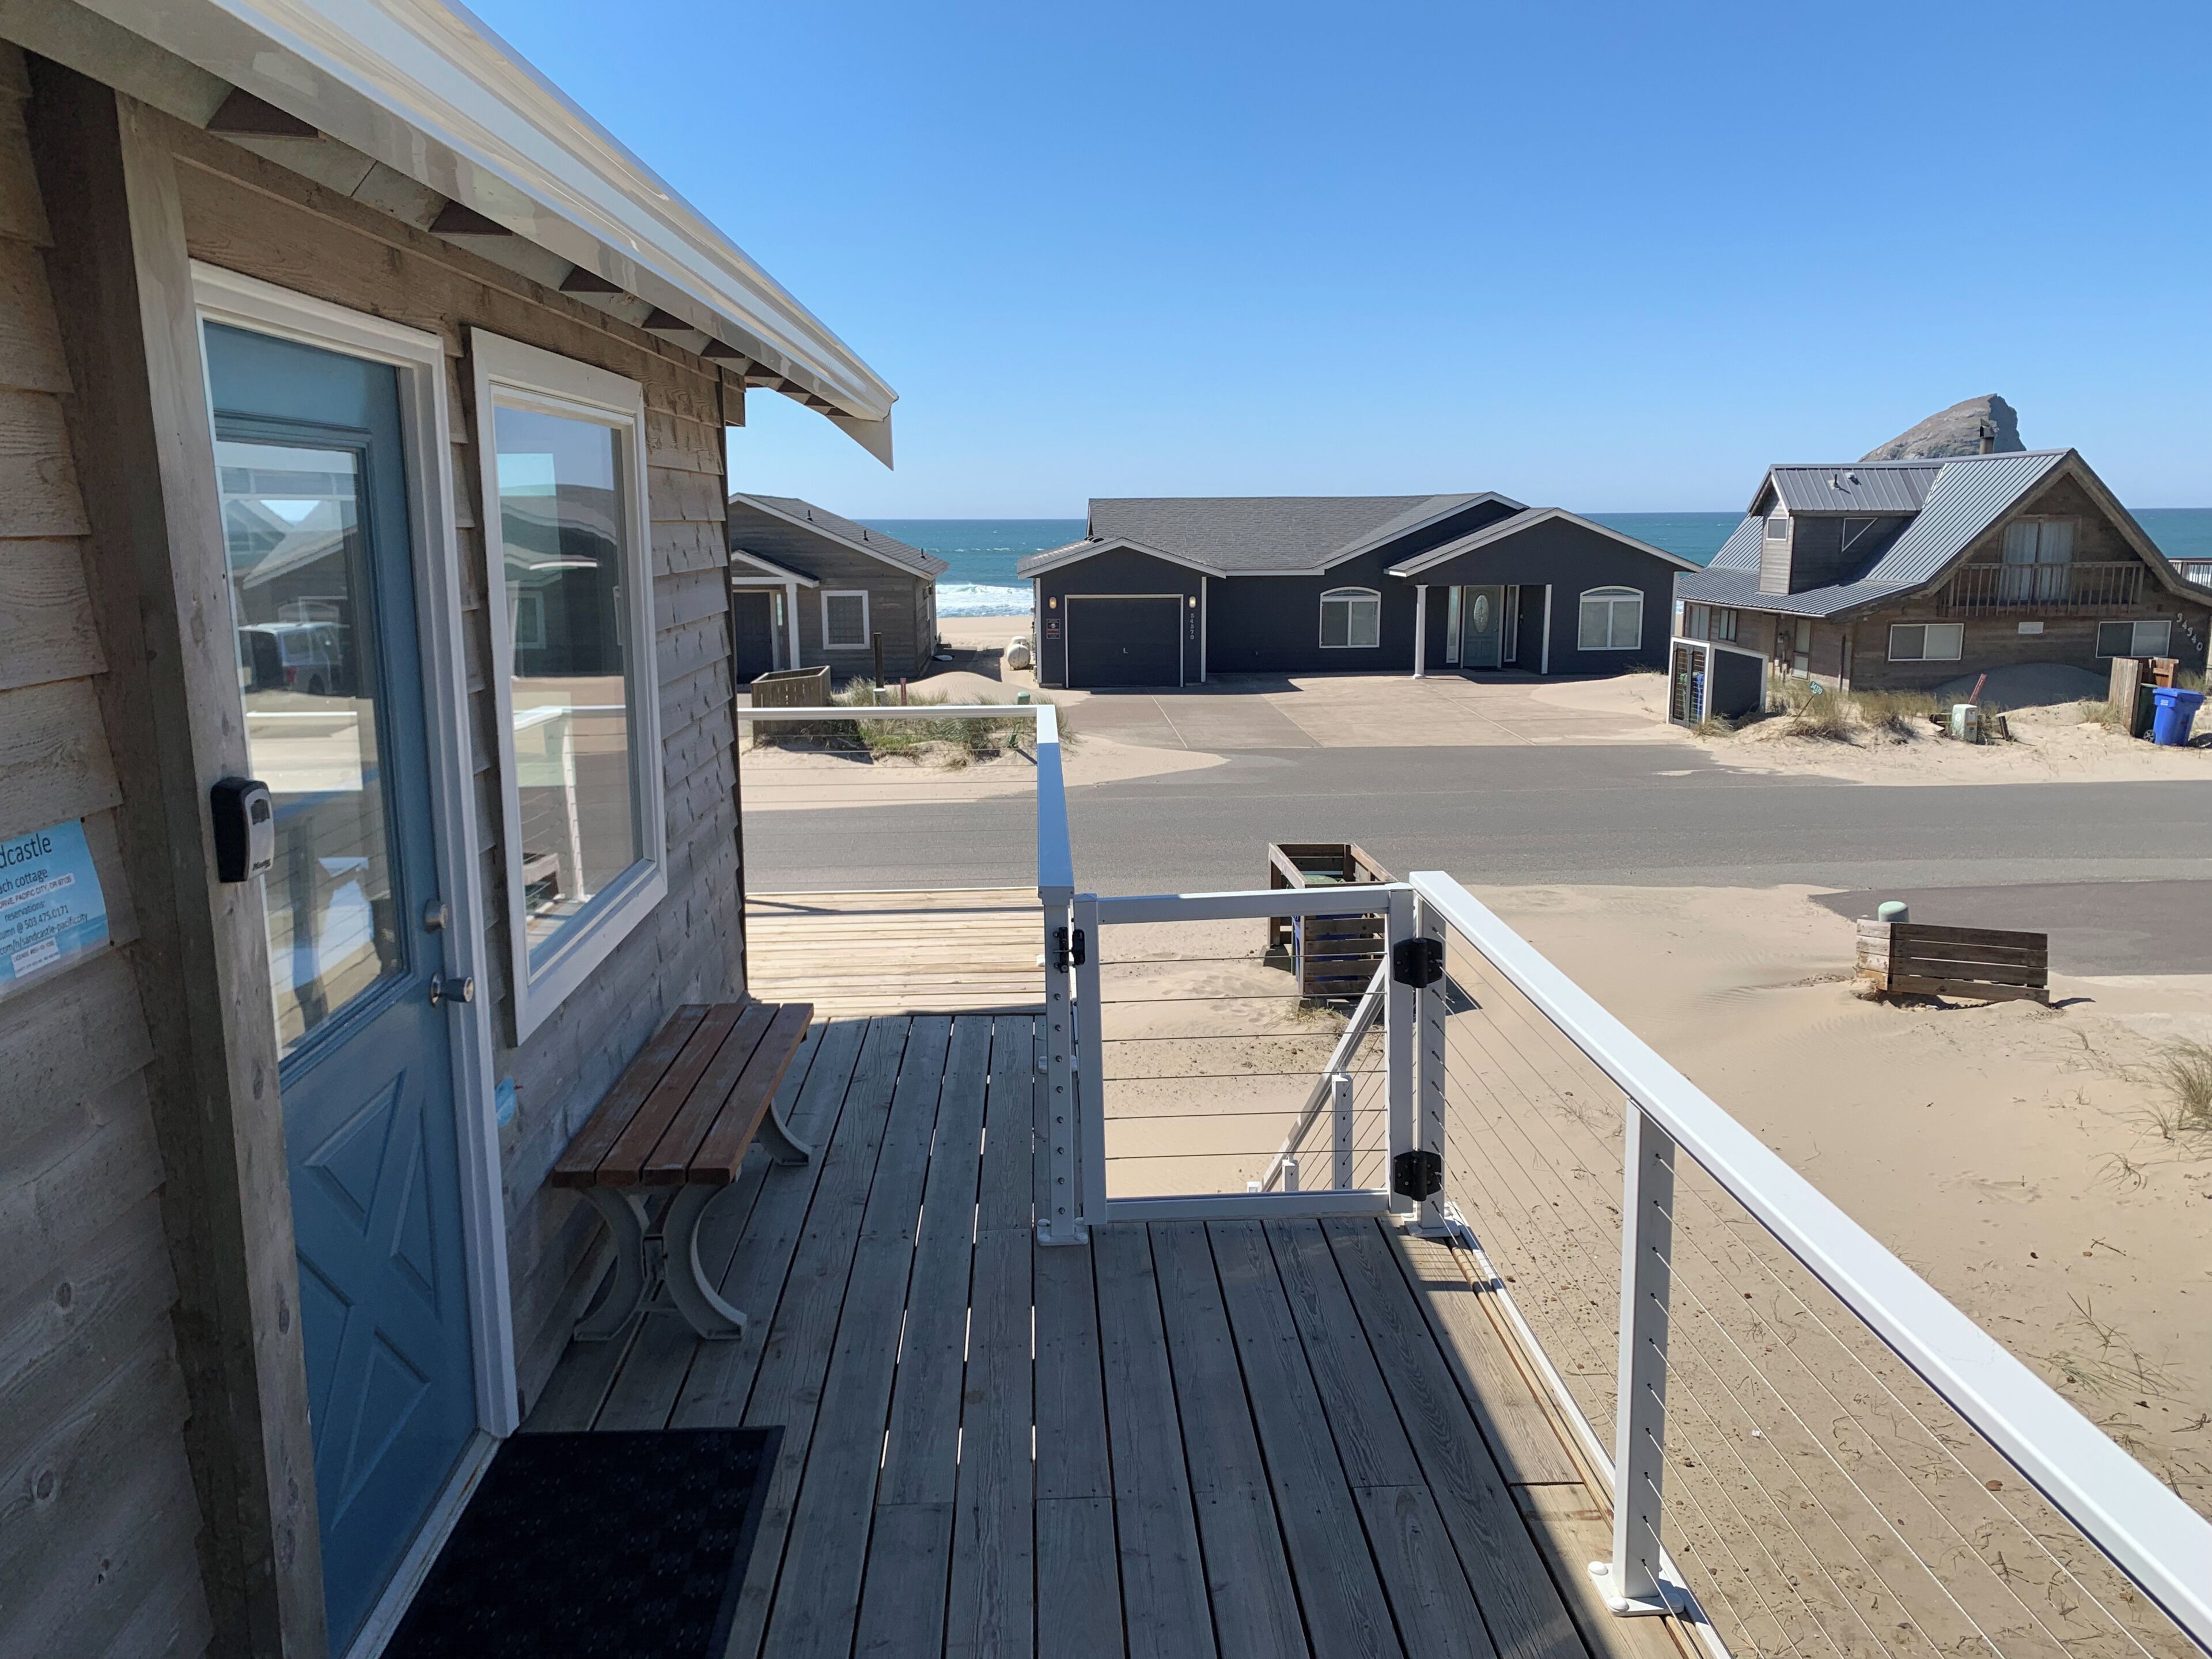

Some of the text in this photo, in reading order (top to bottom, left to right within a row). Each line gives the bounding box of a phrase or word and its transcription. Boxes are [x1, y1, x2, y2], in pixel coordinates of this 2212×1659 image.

[15, 869, 48, 888] cottage
[16, 889, 36, 903] PACIFIC
[5, 900, 46, 922] reservations:
